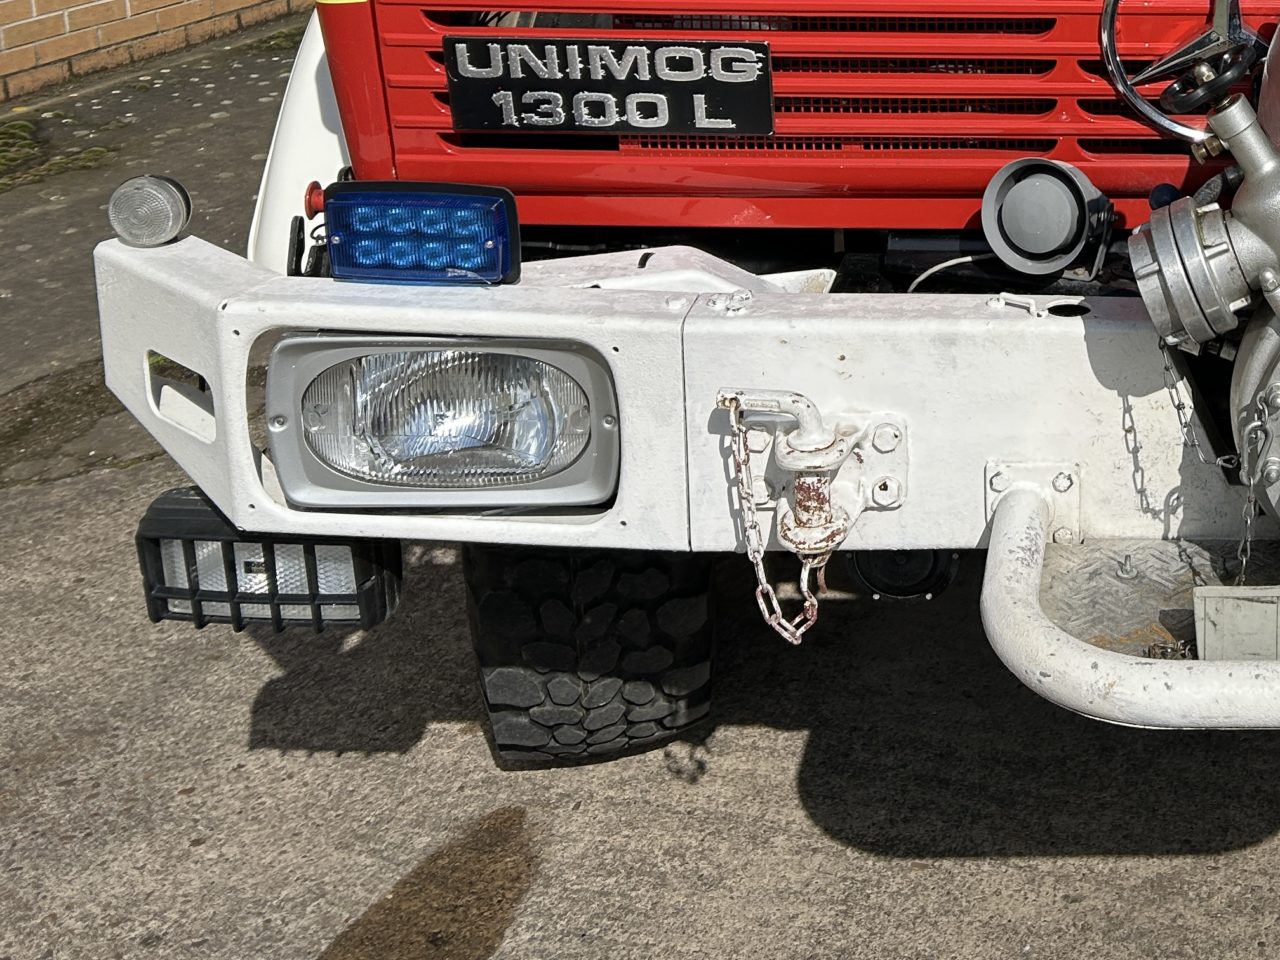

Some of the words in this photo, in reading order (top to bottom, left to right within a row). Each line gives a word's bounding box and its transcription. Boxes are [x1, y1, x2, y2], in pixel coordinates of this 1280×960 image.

[455, 43, 764, 83] UNIMOG
[492, 91, 669, 128] 1300
[693, 94, 736, 129] L
